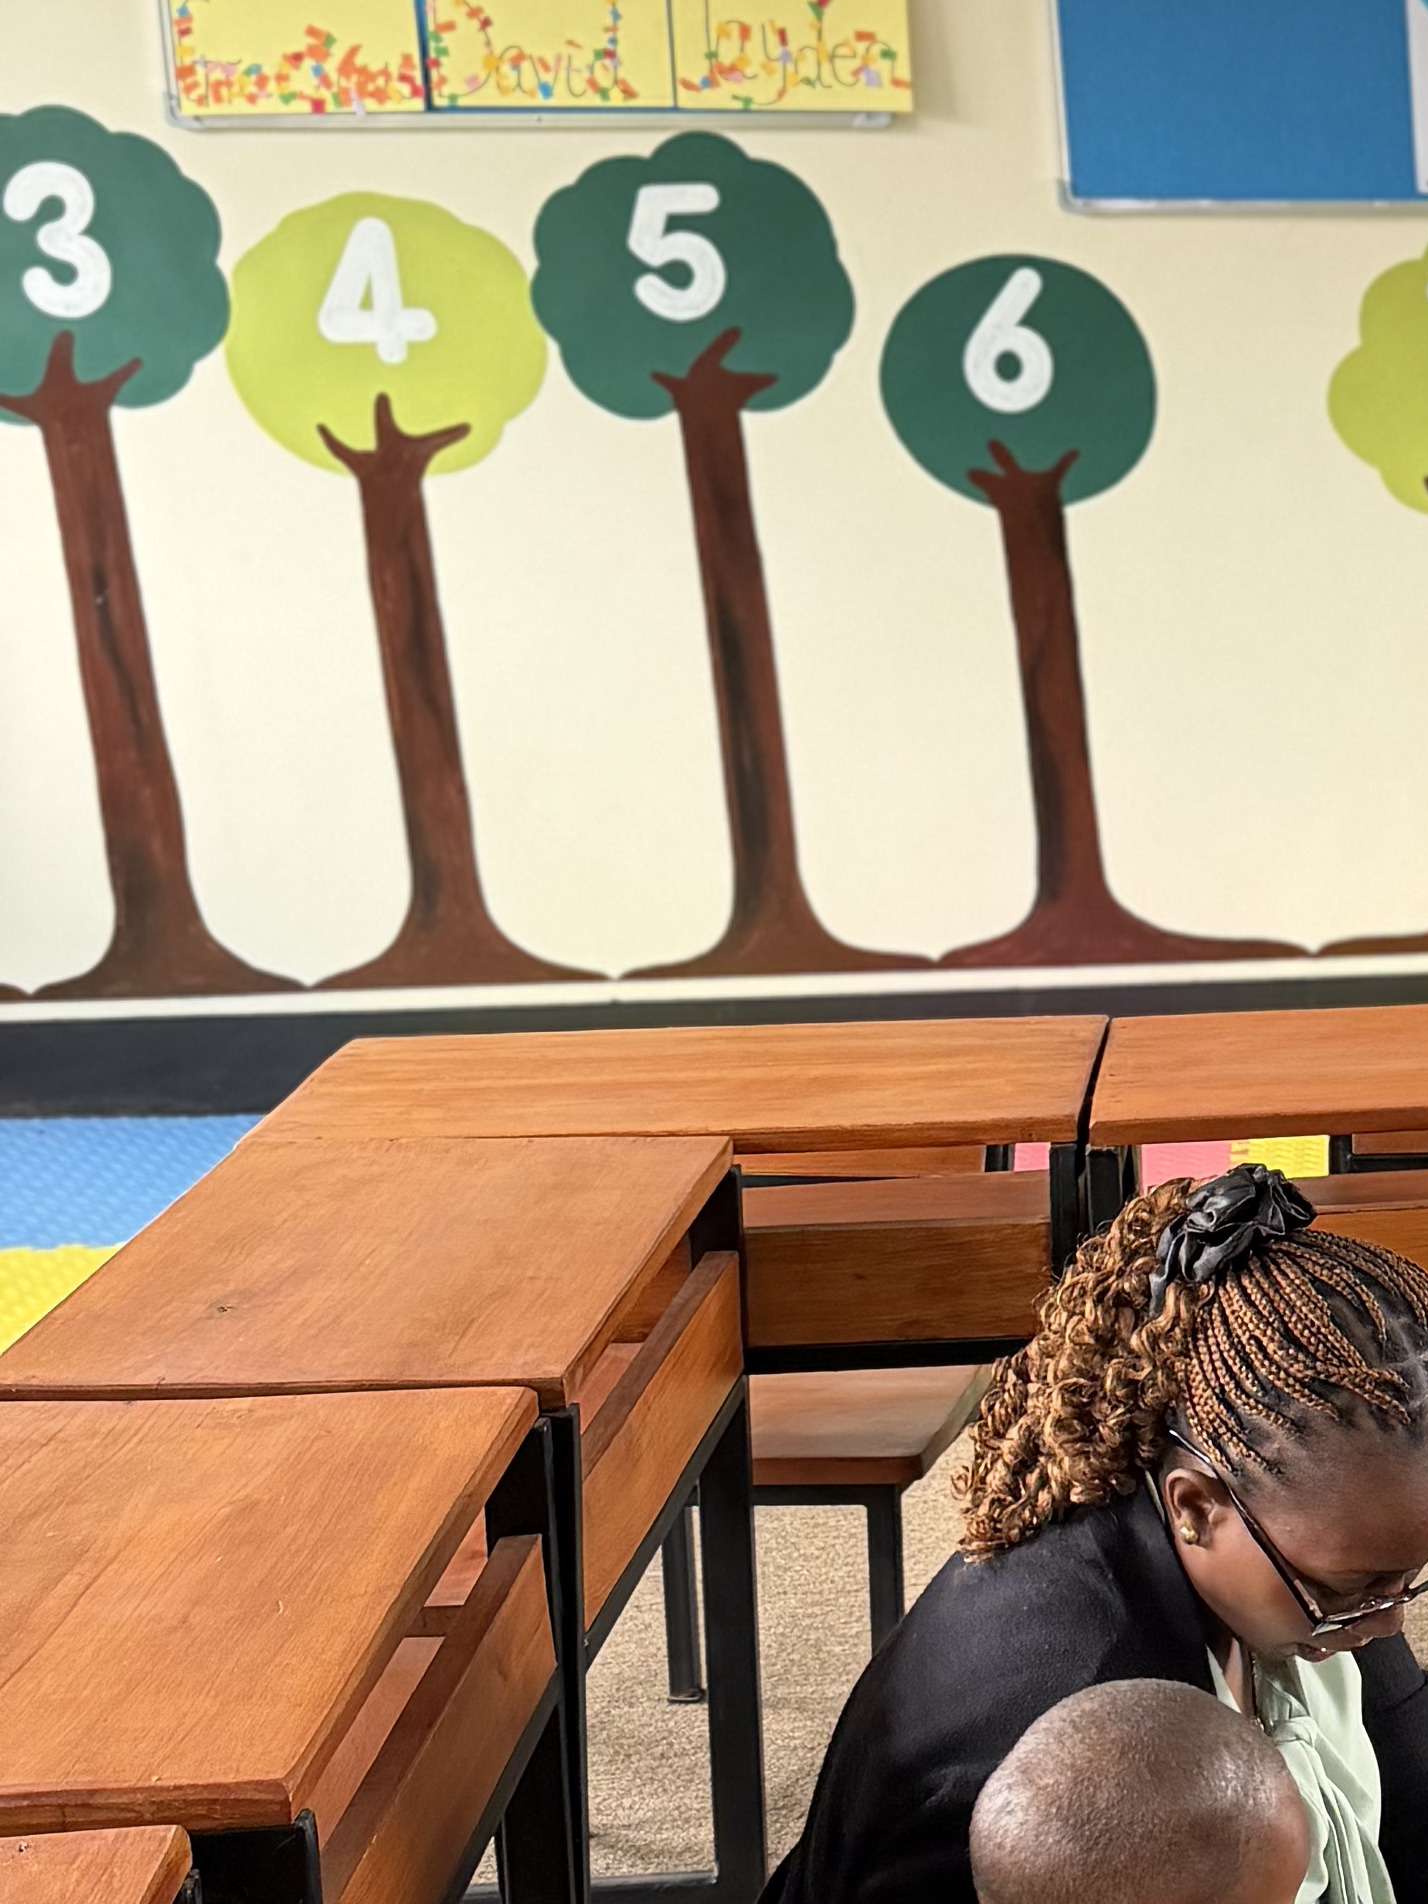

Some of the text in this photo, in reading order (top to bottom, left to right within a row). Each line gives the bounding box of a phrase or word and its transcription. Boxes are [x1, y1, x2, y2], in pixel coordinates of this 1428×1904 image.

[2, 160, 112, 320] 3
[317, 216, 437, 366] 4
[627, 182, 726, 322] 5
[963, 267, 1053, 413] 6
